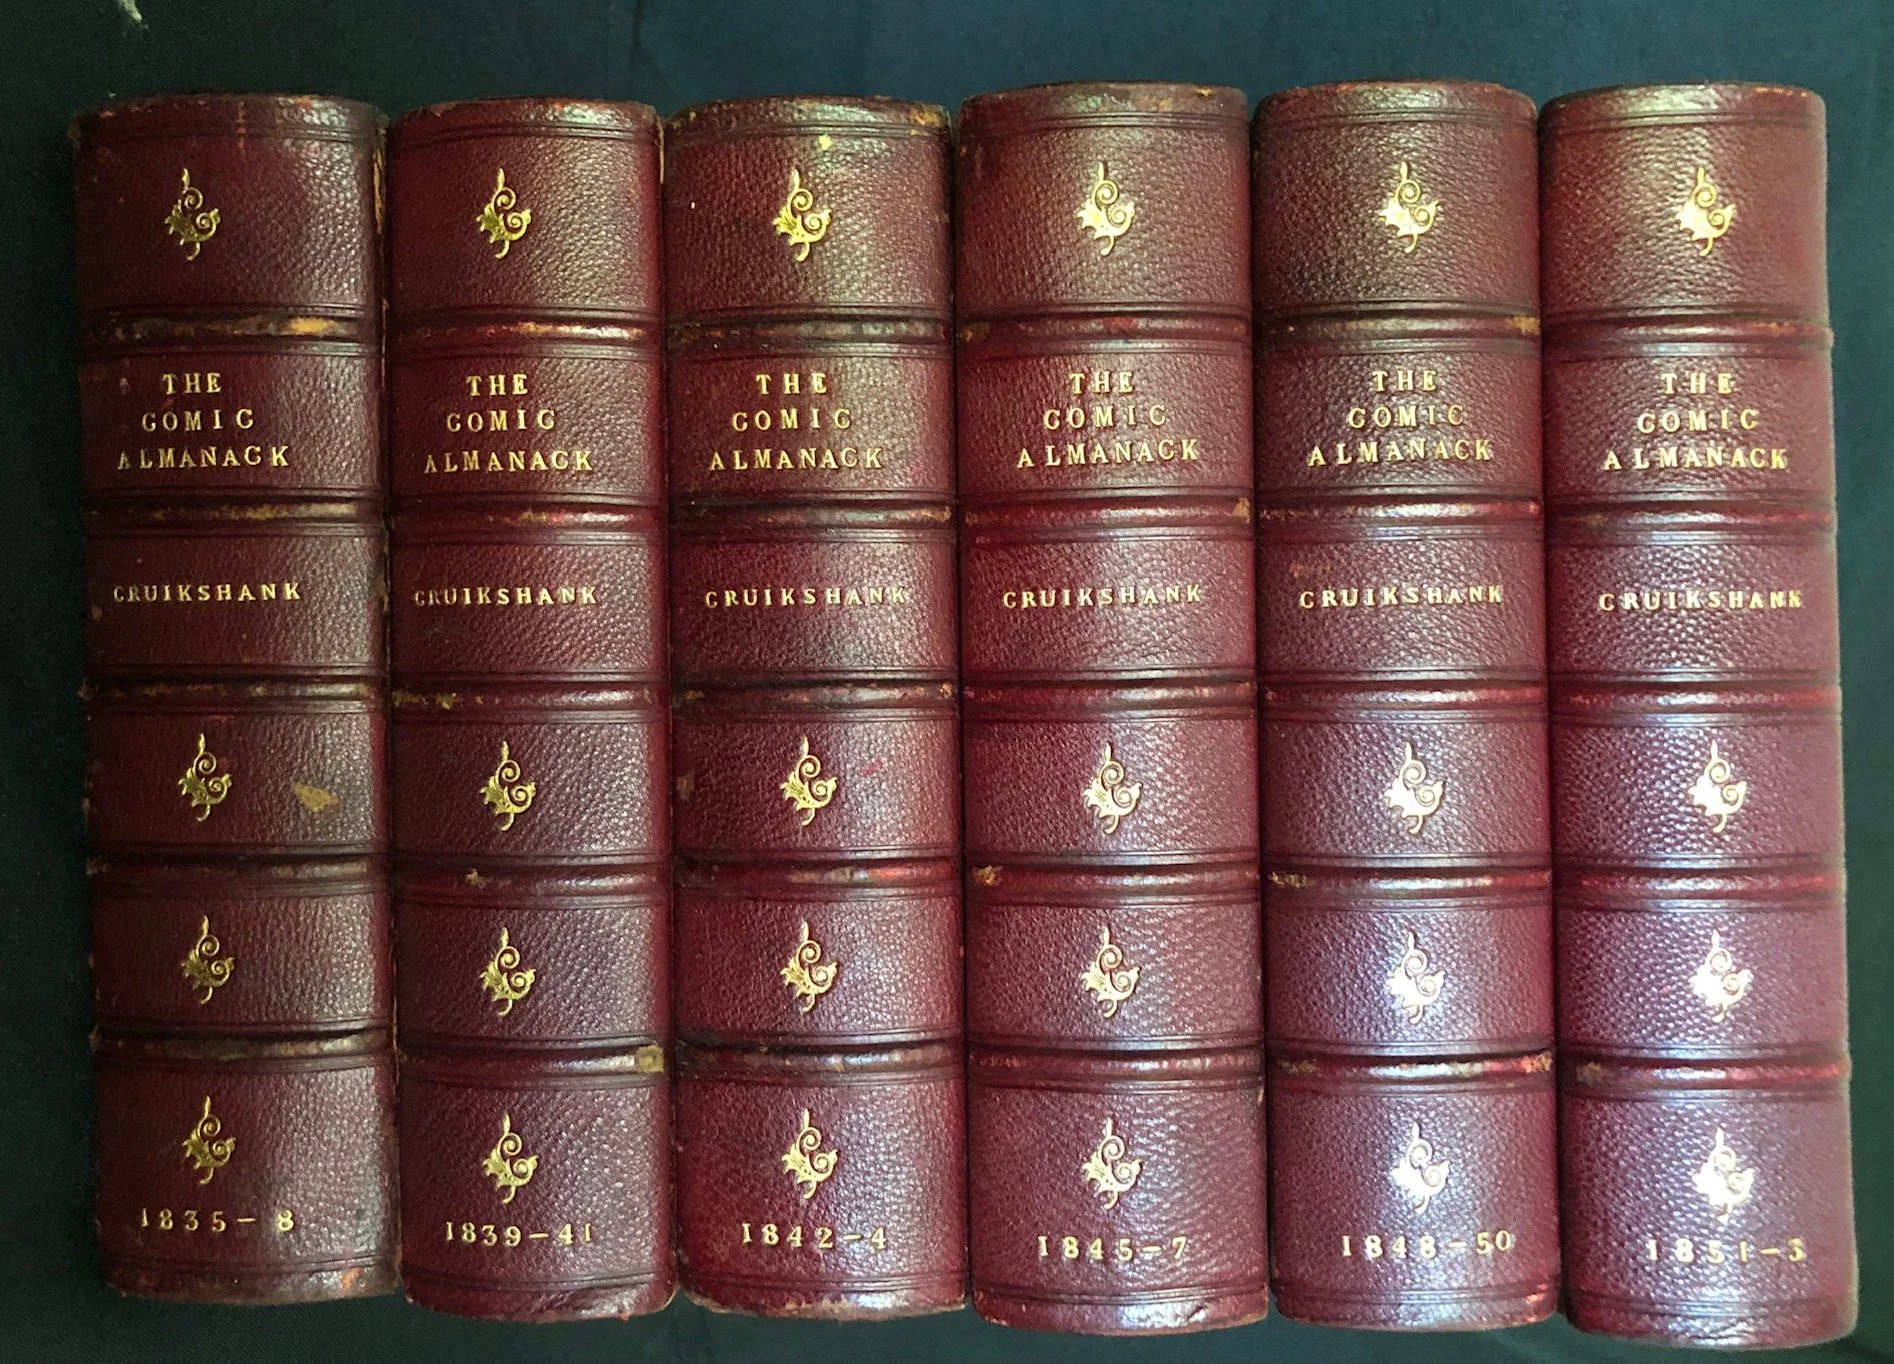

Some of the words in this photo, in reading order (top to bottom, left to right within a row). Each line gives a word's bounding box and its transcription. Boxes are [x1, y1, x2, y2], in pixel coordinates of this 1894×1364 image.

[163, 372, 221, 395] THE
[466, 374, 528, 396] THE
[756, 373, 827, 394] THE
[1070, 371, 1133, 394] THE
[1372, 369, 1437, 391] THE
[1661, 373, 1734, 394] THE
[142, 408, 254, 432] COMIC
[447, 409, 555, 432] COMIC
[732, 408, 851, 431] COMIC
[1043, 405, 1166, 430] COMIC
[1348, 405, 1464, 428] COMIC
[1637, 409, 1759, 433] COMIC
[117, 445, 289, 470] ALMANACK
[424, 450, 593, 474] ALMANACK
[710, 448, 882, 471] ALMANACK
[1017, 439, 1199, 469] ALMANACK
[1308, 439, 1491, 467] ALMANACK
[1604, 447, 1788, 471] ALMANACK
[113, 582, 300, 601] CRUIKSHANK
[415, 586, 597, 607] CRUIKSHANK
[705, 586, 907, 608] CRUIKSHANK
[1003, 584, 1201, 608] CRUIKSHANK
[1300, 585, 1502, 608] CRUIKSHANK
[1599, 590, 1802, 611] CRUIKSHANK
